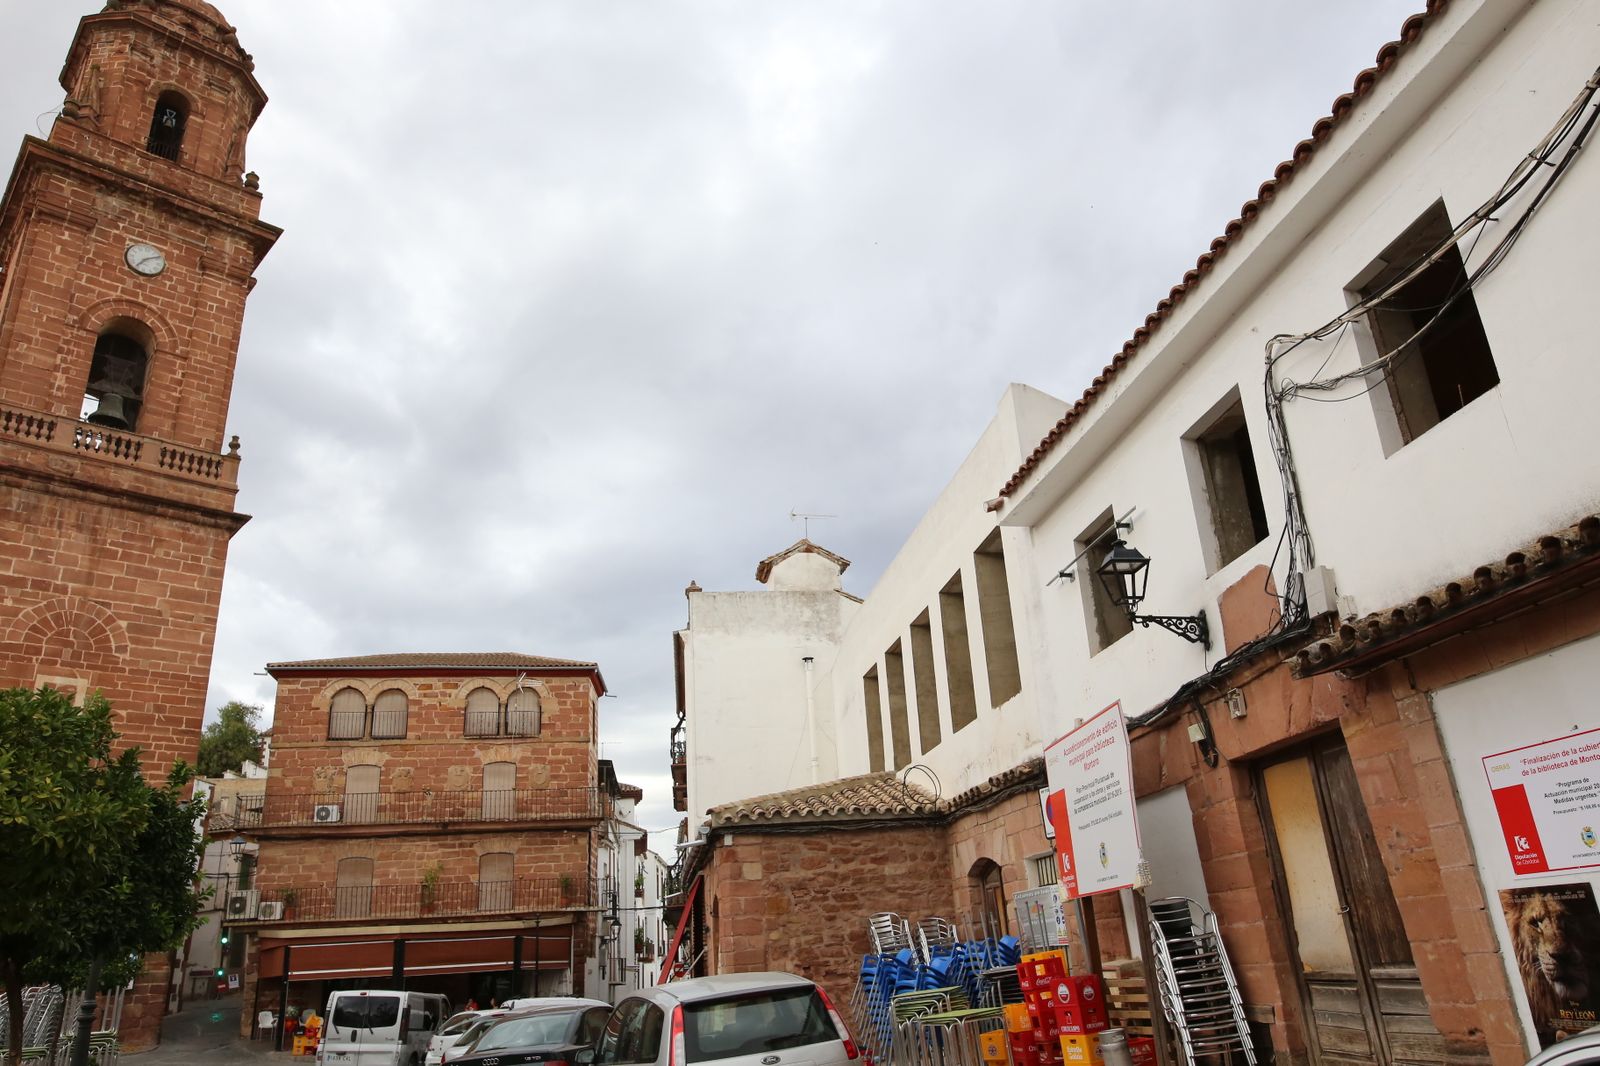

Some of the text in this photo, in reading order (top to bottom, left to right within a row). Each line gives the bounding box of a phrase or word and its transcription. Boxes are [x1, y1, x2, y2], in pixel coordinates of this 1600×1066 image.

[1530, 767, 1537, 775] la
[1537, 761, 1569, 773] biblioteca
[1569, 758, 1578, 766] de
[1559, 1009, 1574, 1020] REY
